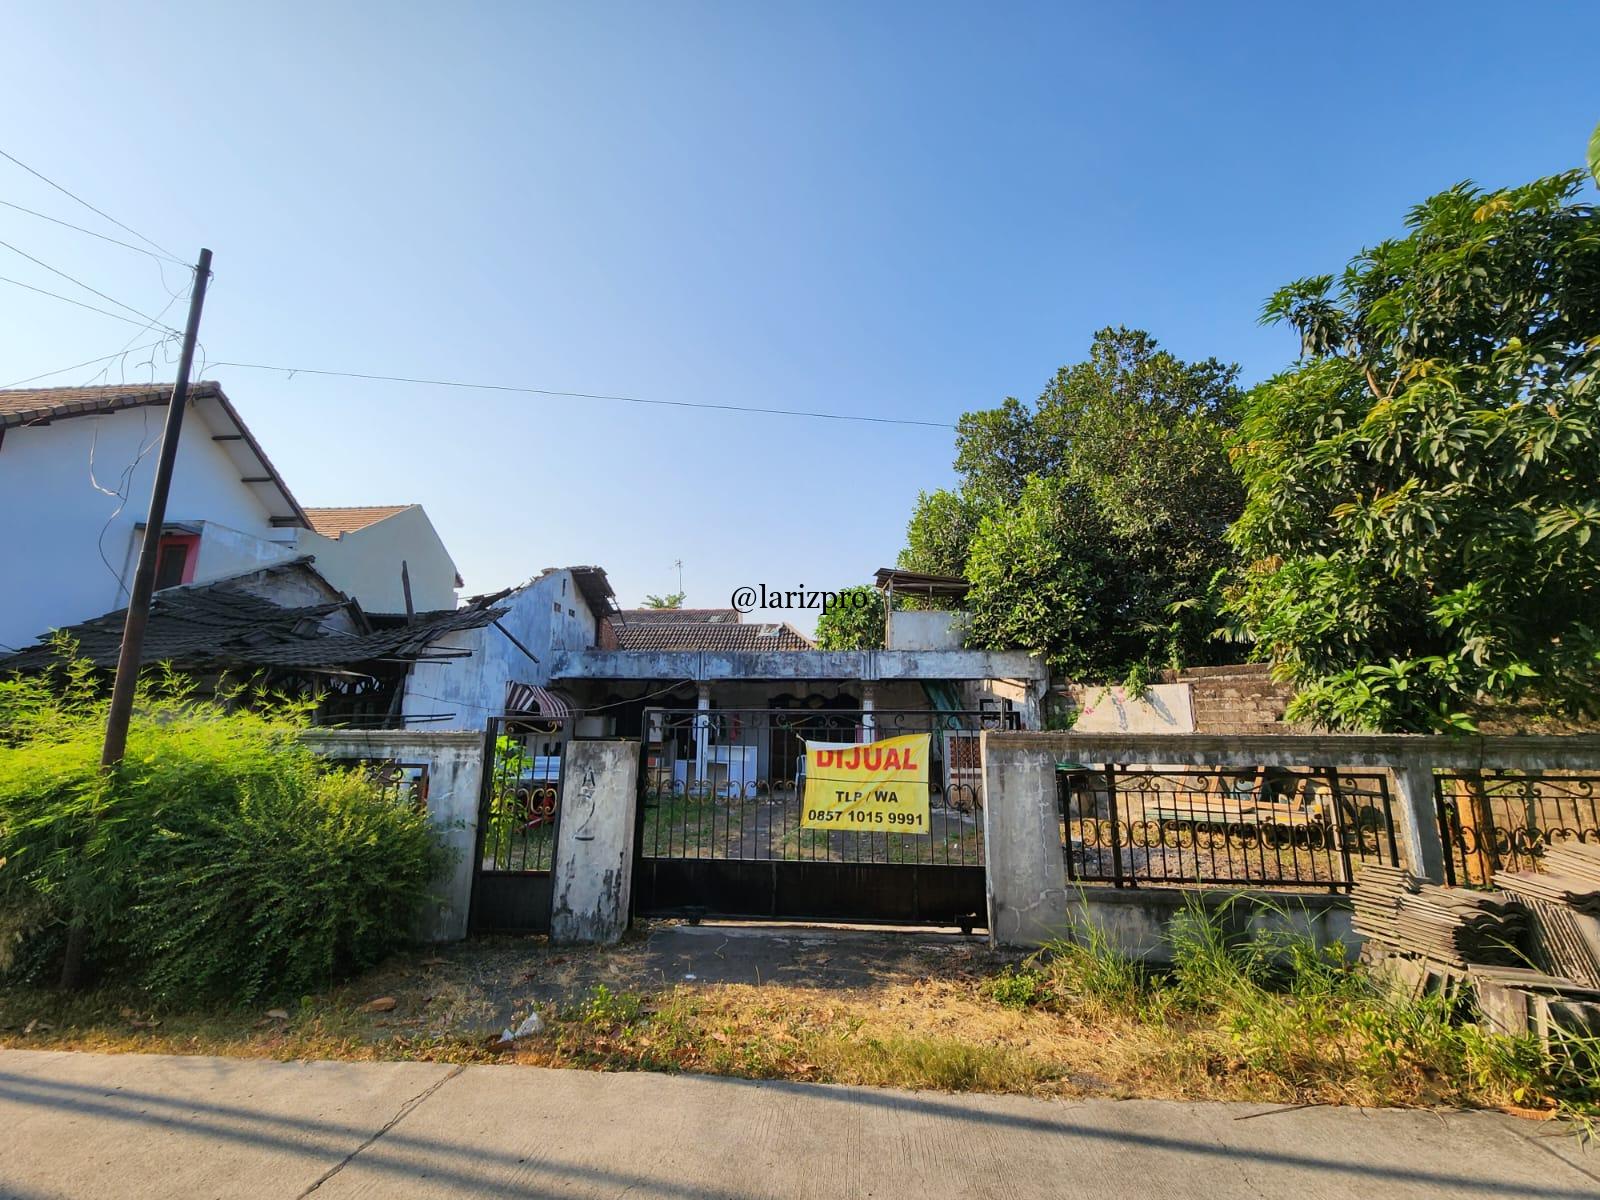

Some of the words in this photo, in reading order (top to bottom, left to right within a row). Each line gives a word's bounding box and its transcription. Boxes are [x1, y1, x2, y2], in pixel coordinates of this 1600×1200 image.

[816, 746, 918, 772] DIJUAL
[835, 790, 863, 803] TLP
[874, 790, 898, 803] WA
[808, 809, 843, 822] 0857
[847, 810, 884, 824] 1015
[887, 812, 923, 826] 9991
